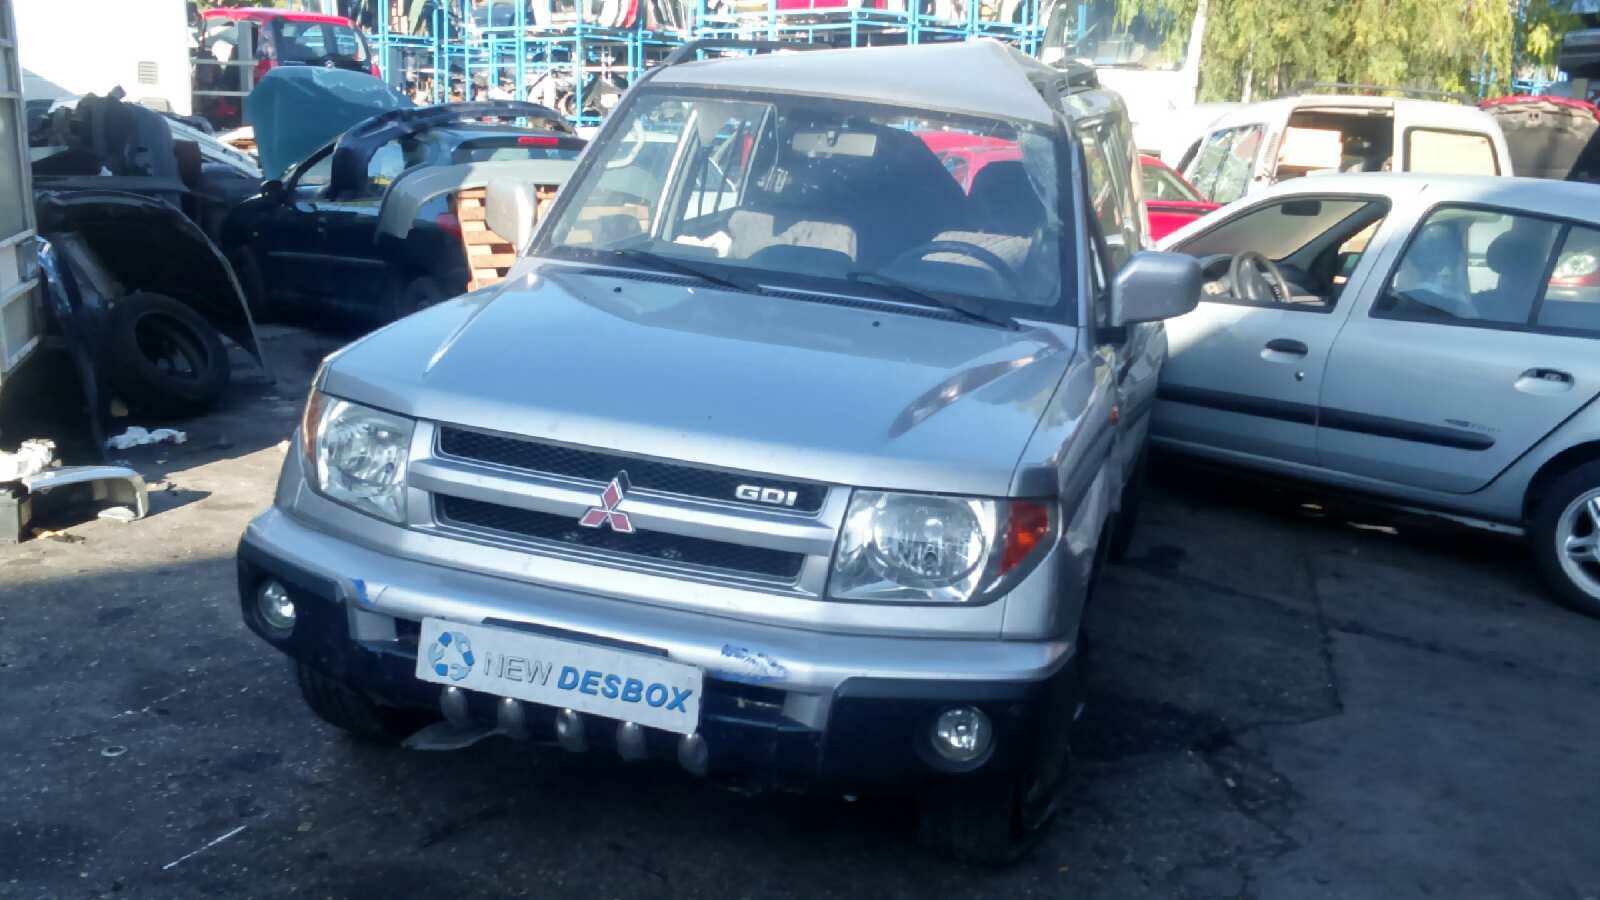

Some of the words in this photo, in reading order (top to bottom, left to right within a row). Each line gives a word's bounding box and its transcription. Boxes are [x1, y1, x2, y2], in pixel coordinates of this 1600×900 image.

[735, 484, 798, 506] GDI
[483, 651, 552, 686] NEW
[557, 666, 693, 712] DESBOX
